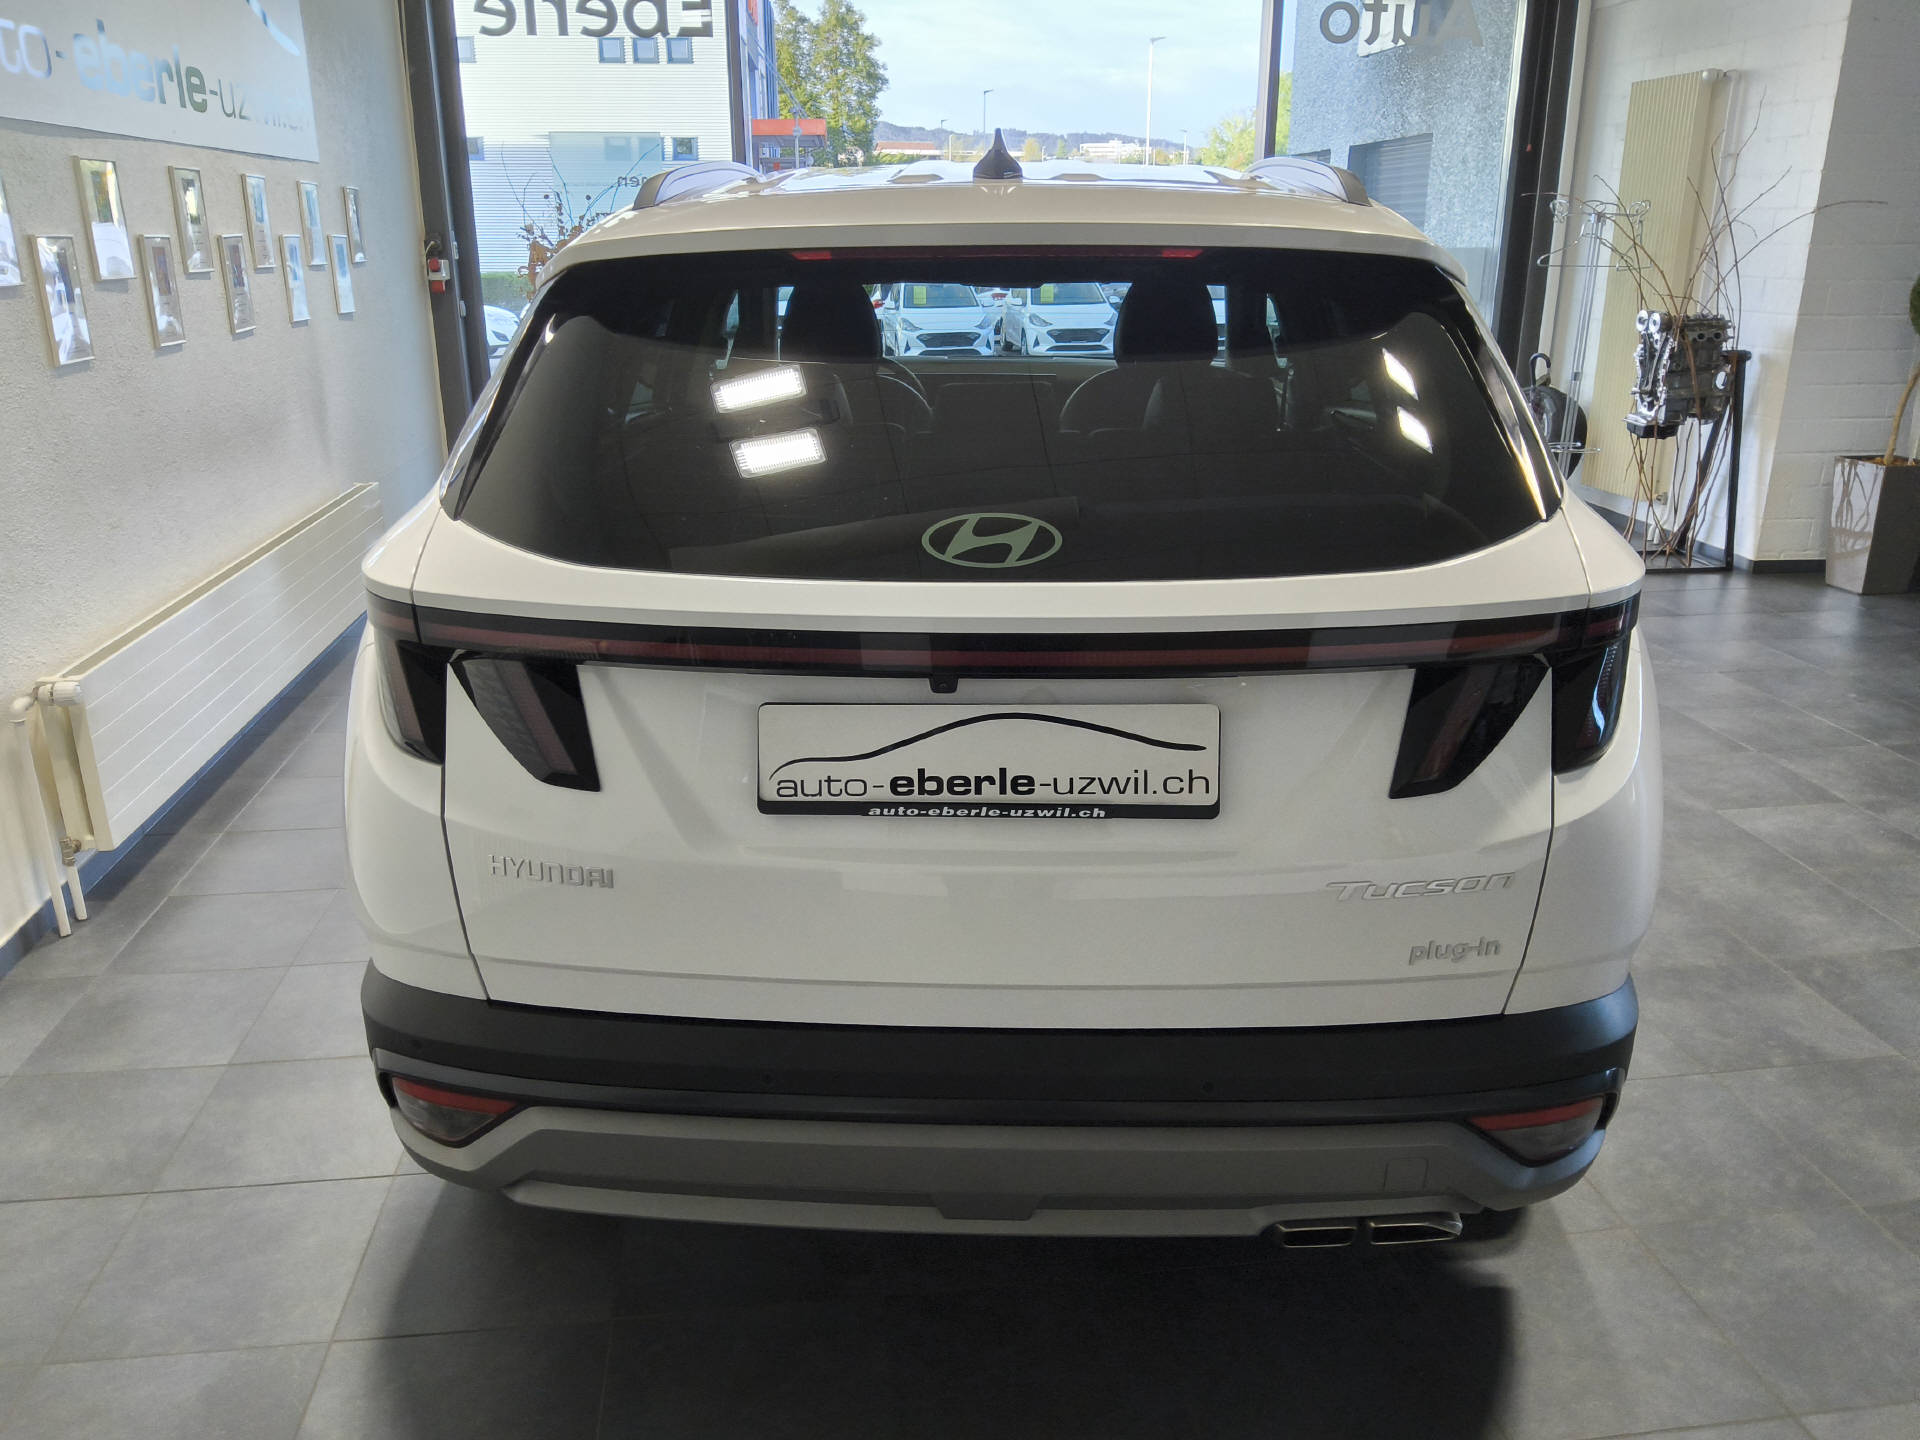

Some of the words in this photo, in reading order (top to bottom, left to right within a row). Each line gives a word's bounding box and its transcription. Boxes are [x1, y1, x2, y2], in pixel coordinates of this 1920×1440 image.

[775, 768, 1211, 798] auto-eberle-uzwil.ch
[868, 806, 1107, 819] auto-eberle-uzwil.ch
[488, 854, 614, 889] HYUNDAI
[1408, 936, 1501, 966] plug-in
